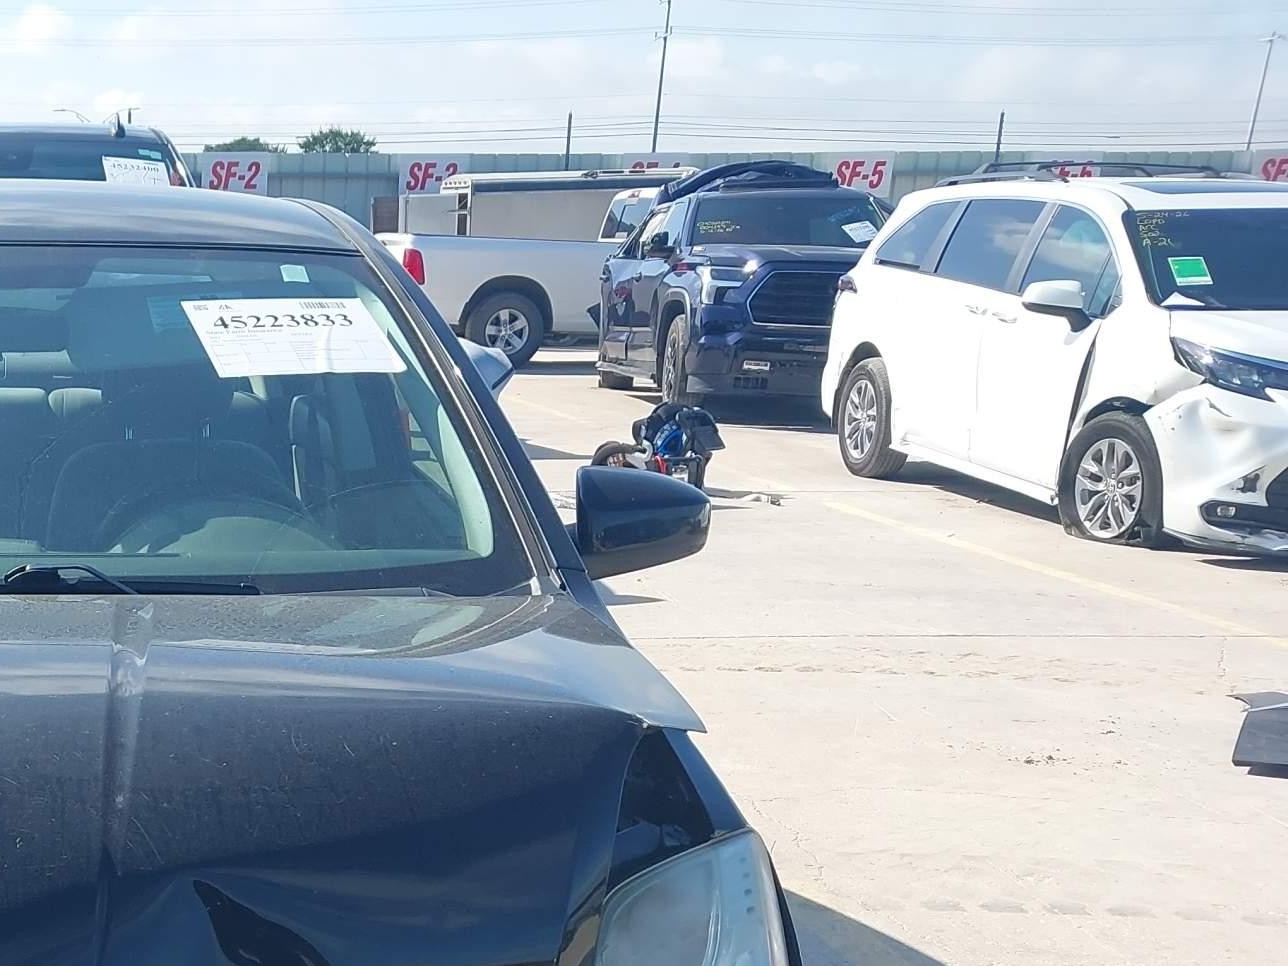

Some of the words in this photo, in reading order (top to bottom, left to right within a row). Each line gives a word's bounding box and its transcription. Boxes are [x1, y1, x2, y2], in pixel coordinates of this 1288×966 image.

[209, 160, 261, 190] SF-2
[836, 160, 887, 189] SF-5
[213, 313, 353, 330] 45223833
